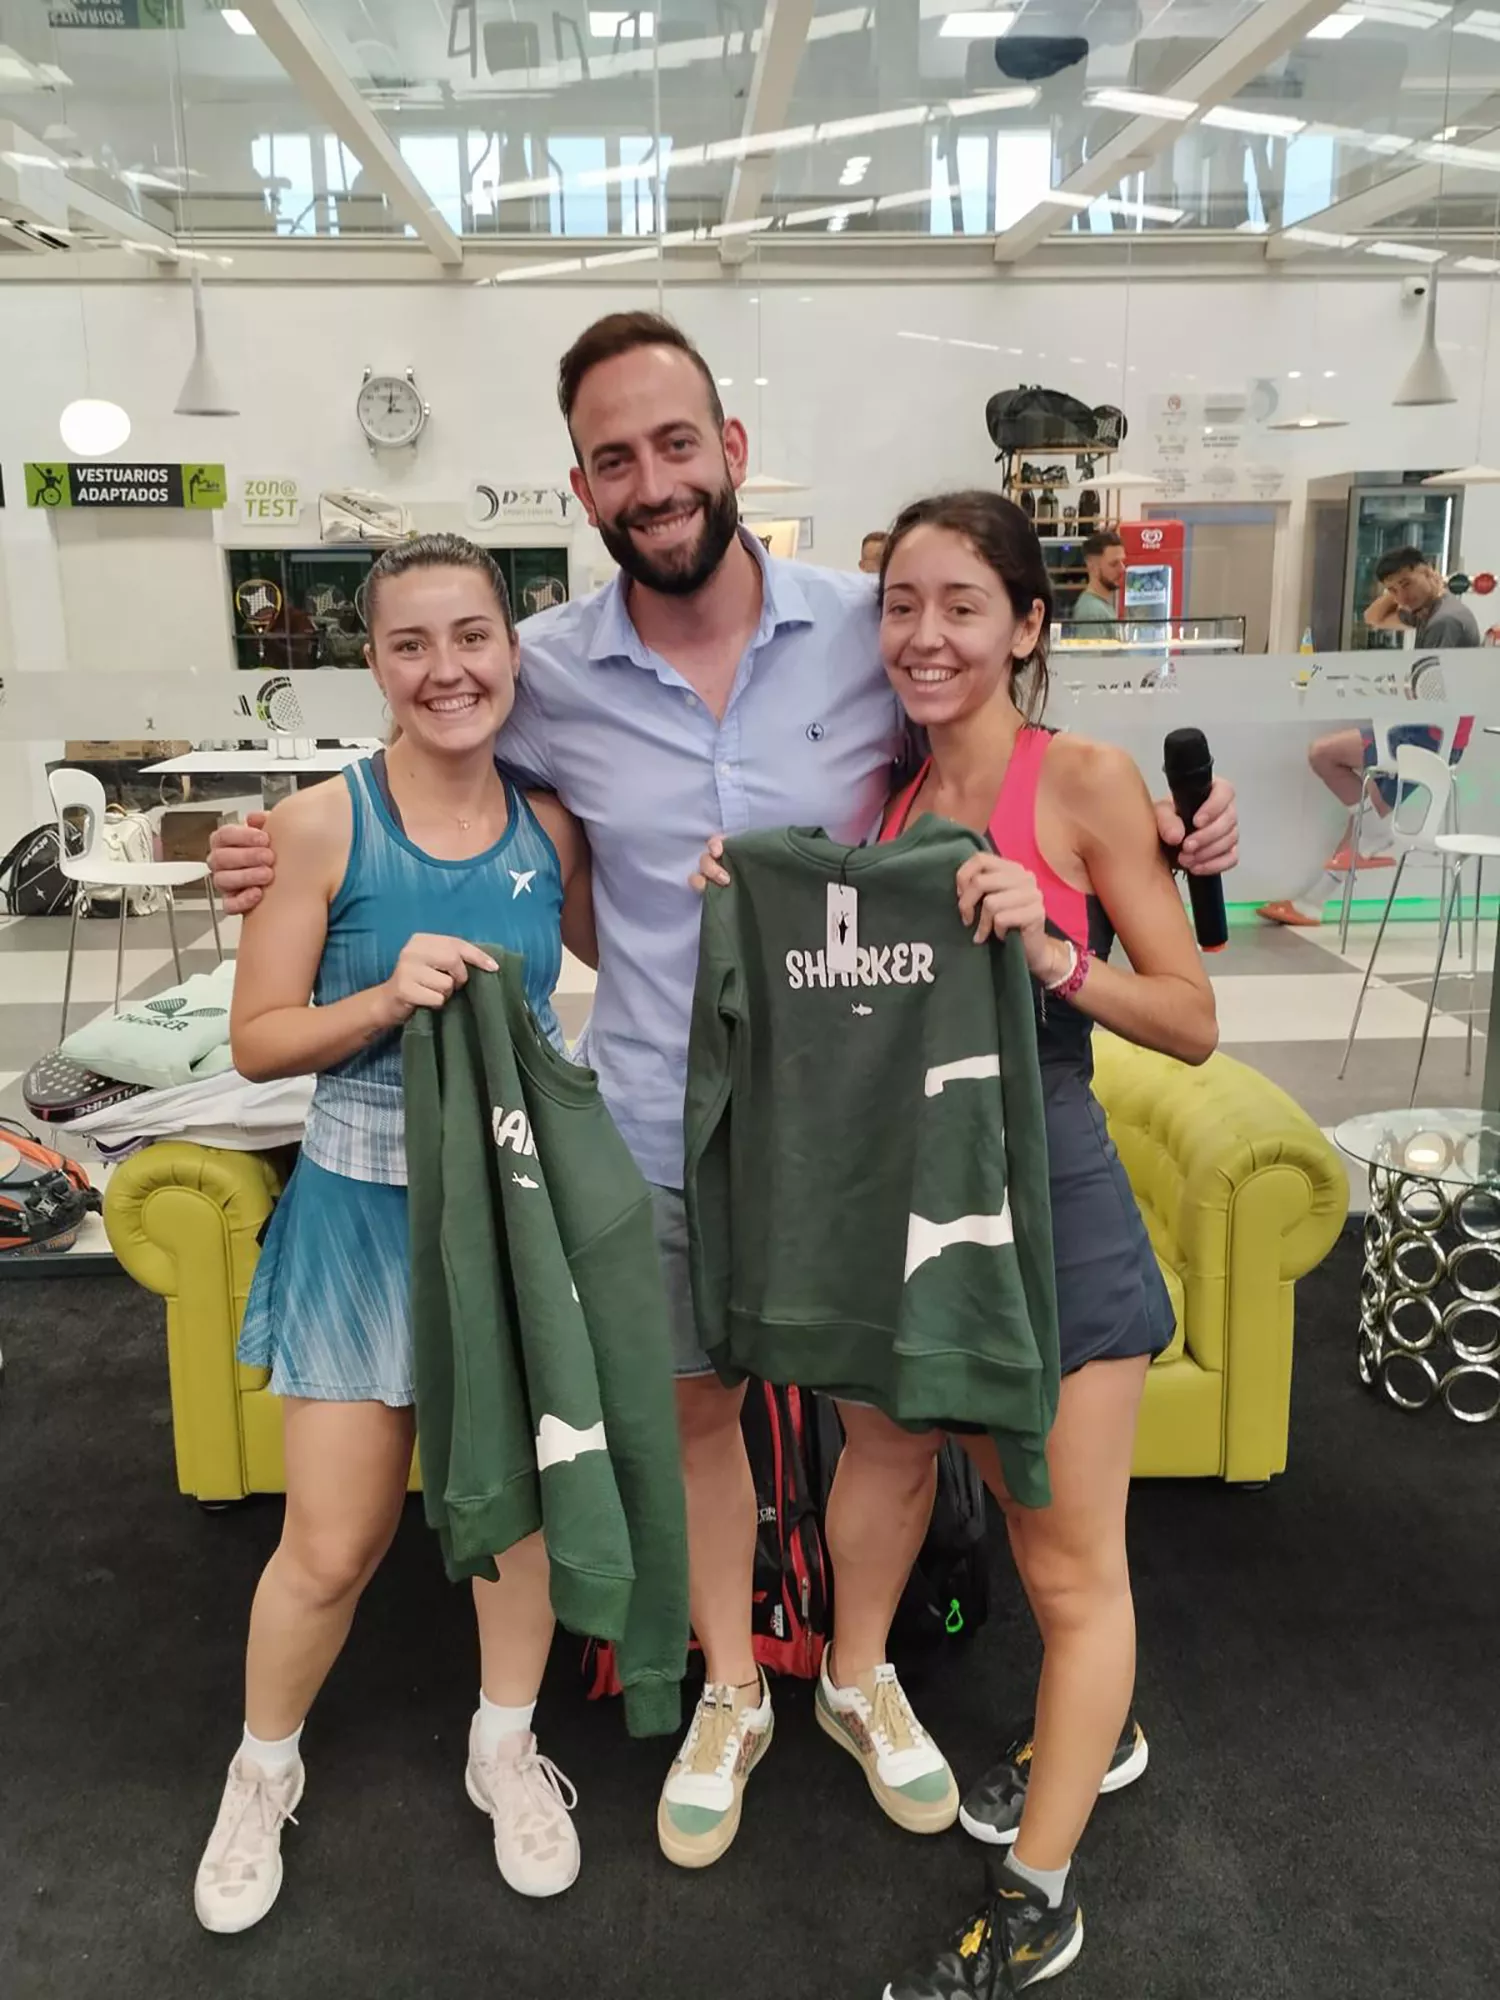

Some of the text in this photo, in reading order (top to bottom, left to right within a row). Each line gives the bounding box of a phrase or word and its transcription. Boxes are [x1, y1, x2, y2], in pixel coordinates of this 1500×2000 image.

[76, 468, 168, 483] VESTUARIOS
[78, 487, 169, 502] ADAPTADOS
[245, 479, 298, 496] zon@
[502, 490, 548, 504] DST
[246, 499, 298, 517] TEST
